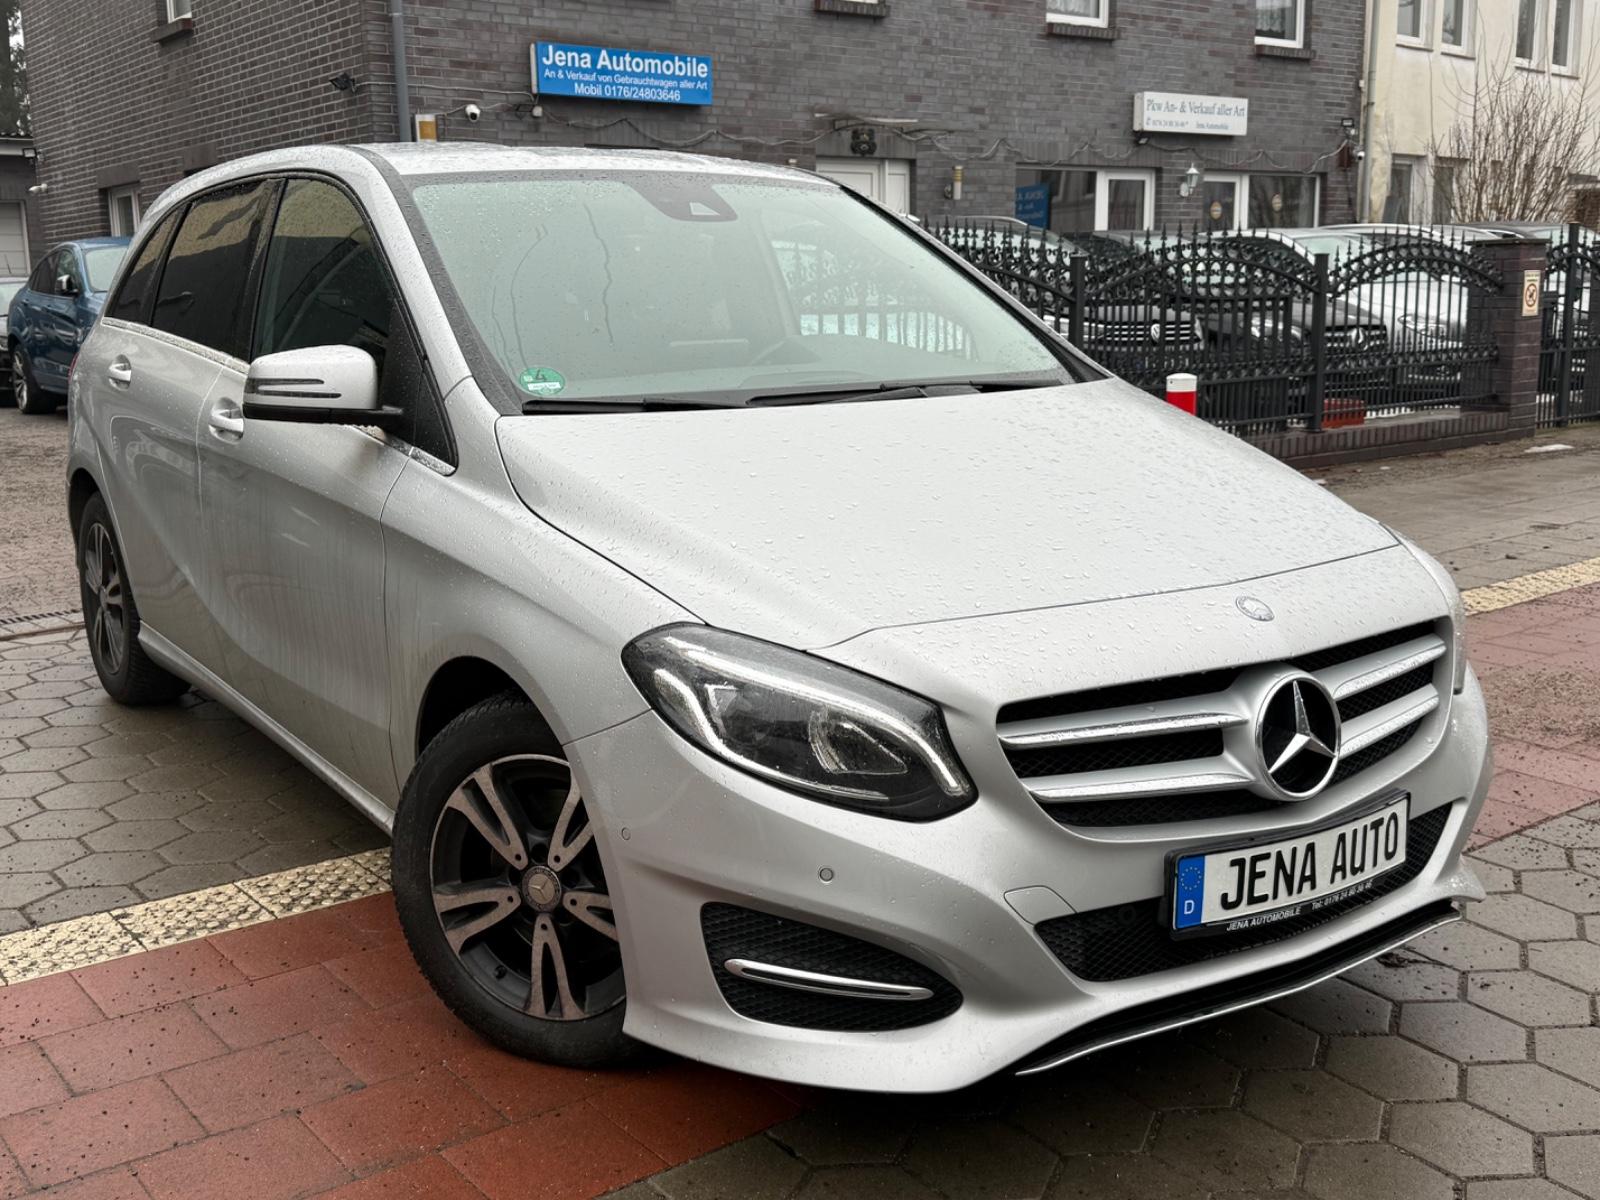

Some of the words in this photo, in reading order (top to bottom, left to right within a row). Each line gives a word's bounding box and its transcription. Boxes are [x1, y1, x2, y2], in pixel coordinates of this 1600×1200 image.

[542, 45, 591, 69] Jena
[597, 50, 708, 78] Automobile
[544, 67, 556, 78] An
[557, 69, 564, 79] &
[565, 70, 596, 81] Verkauf
[597, 74, 612, 83] von
[613, 74, 678, 88] Gebrauchtwagen
[679, 79, 695, 89] aller
[696, 80, 708, 90] Art
[574, 82, 602, 96] Mobil
[604, 84, 681, 101] 0176/24803646
[1188, 101, 1216, 115] Verkauf
[1217, 103, 1232, 116] aller
[1233, 105, 1245, 117] Art
[1220, 842, 1317, 911] JENA
[1330, 812, 1399, 884] AUTO
[1183, 899, 1195, 915] D
[1226, 919, 1249, 932] JENA
[1250, 906, 1301, 926] AUTOMOBILE
